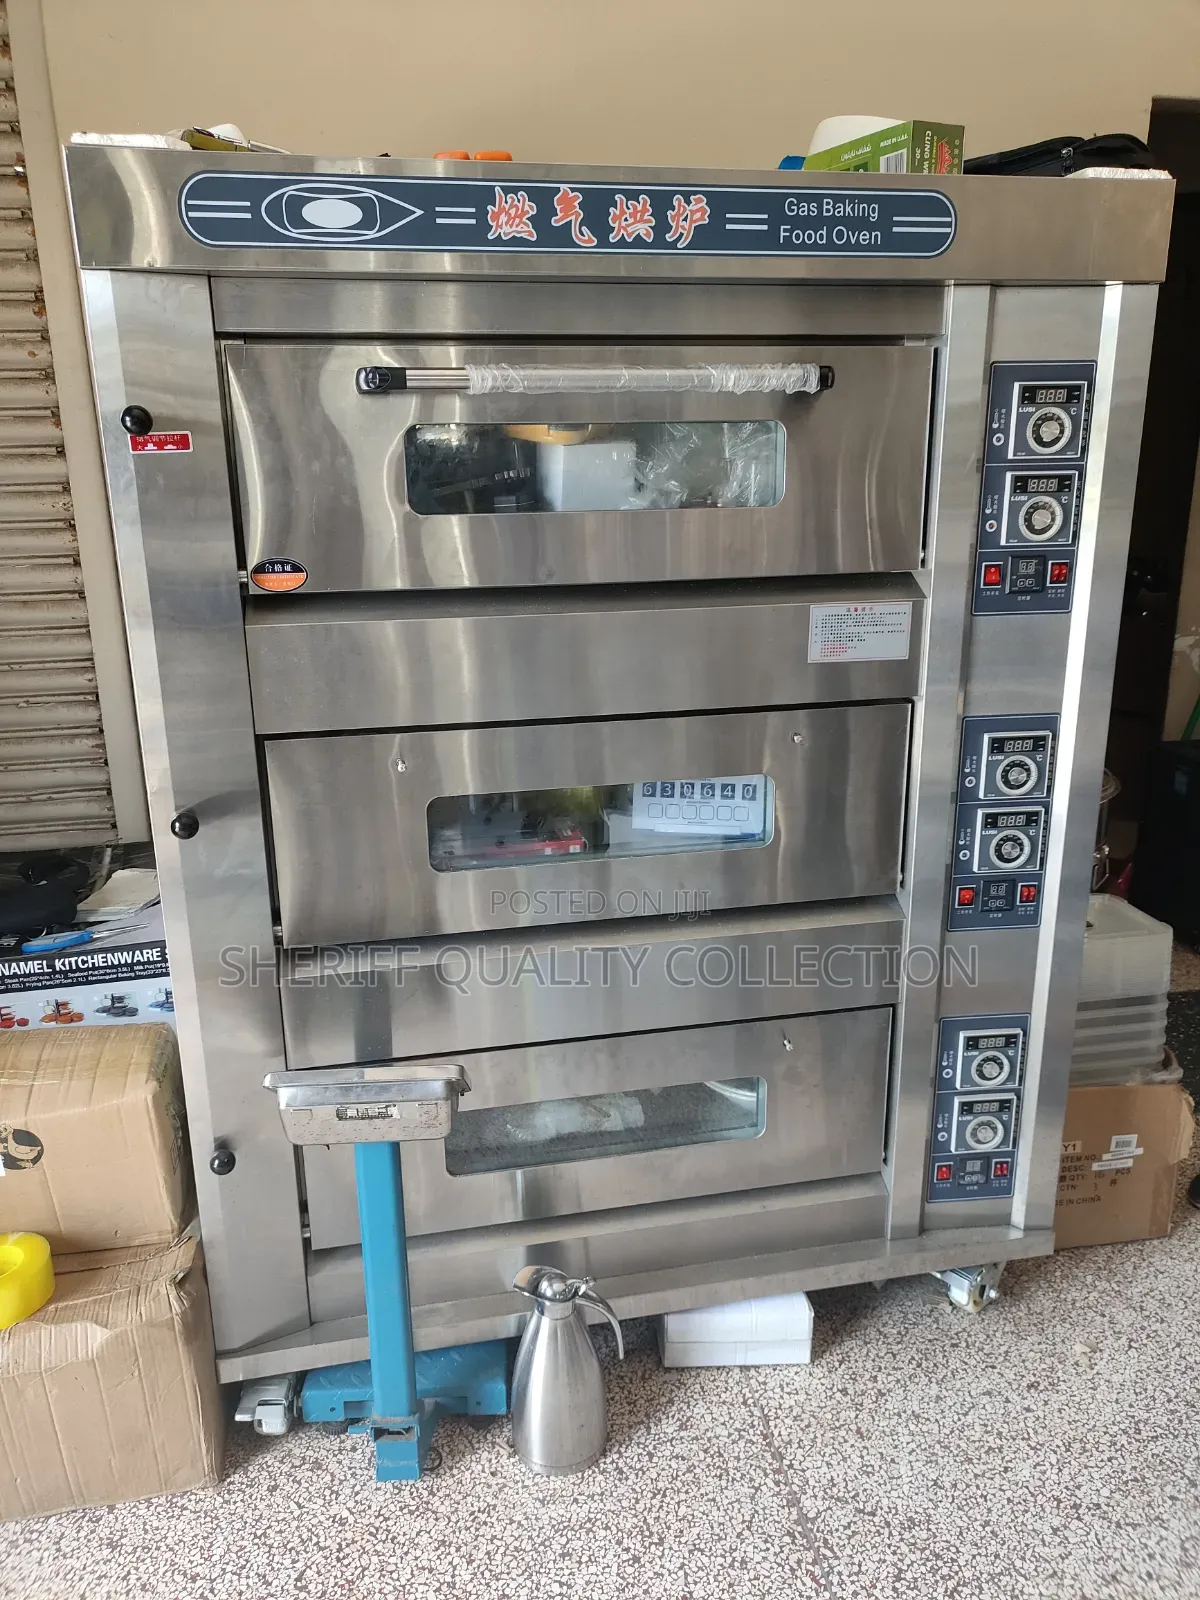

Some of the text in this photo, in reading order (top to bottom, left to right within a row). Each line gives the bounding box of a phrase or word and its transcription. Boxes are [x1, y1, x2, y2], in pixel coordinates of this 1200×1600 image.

[879, 138, 891, 148] MADE
[923, 130, 932, 159] CLING
[487, 186, 710, 248] 燃气烘炉
[785, 197, 880, 222] Gas Baking
[779, 224, 882, 246] Food Oven
[264, 563, 293, 573] 合格证
[55, 947, 163, 971] KITCHENWARE
[1075, 1194, 1102, 1205] CHINA
